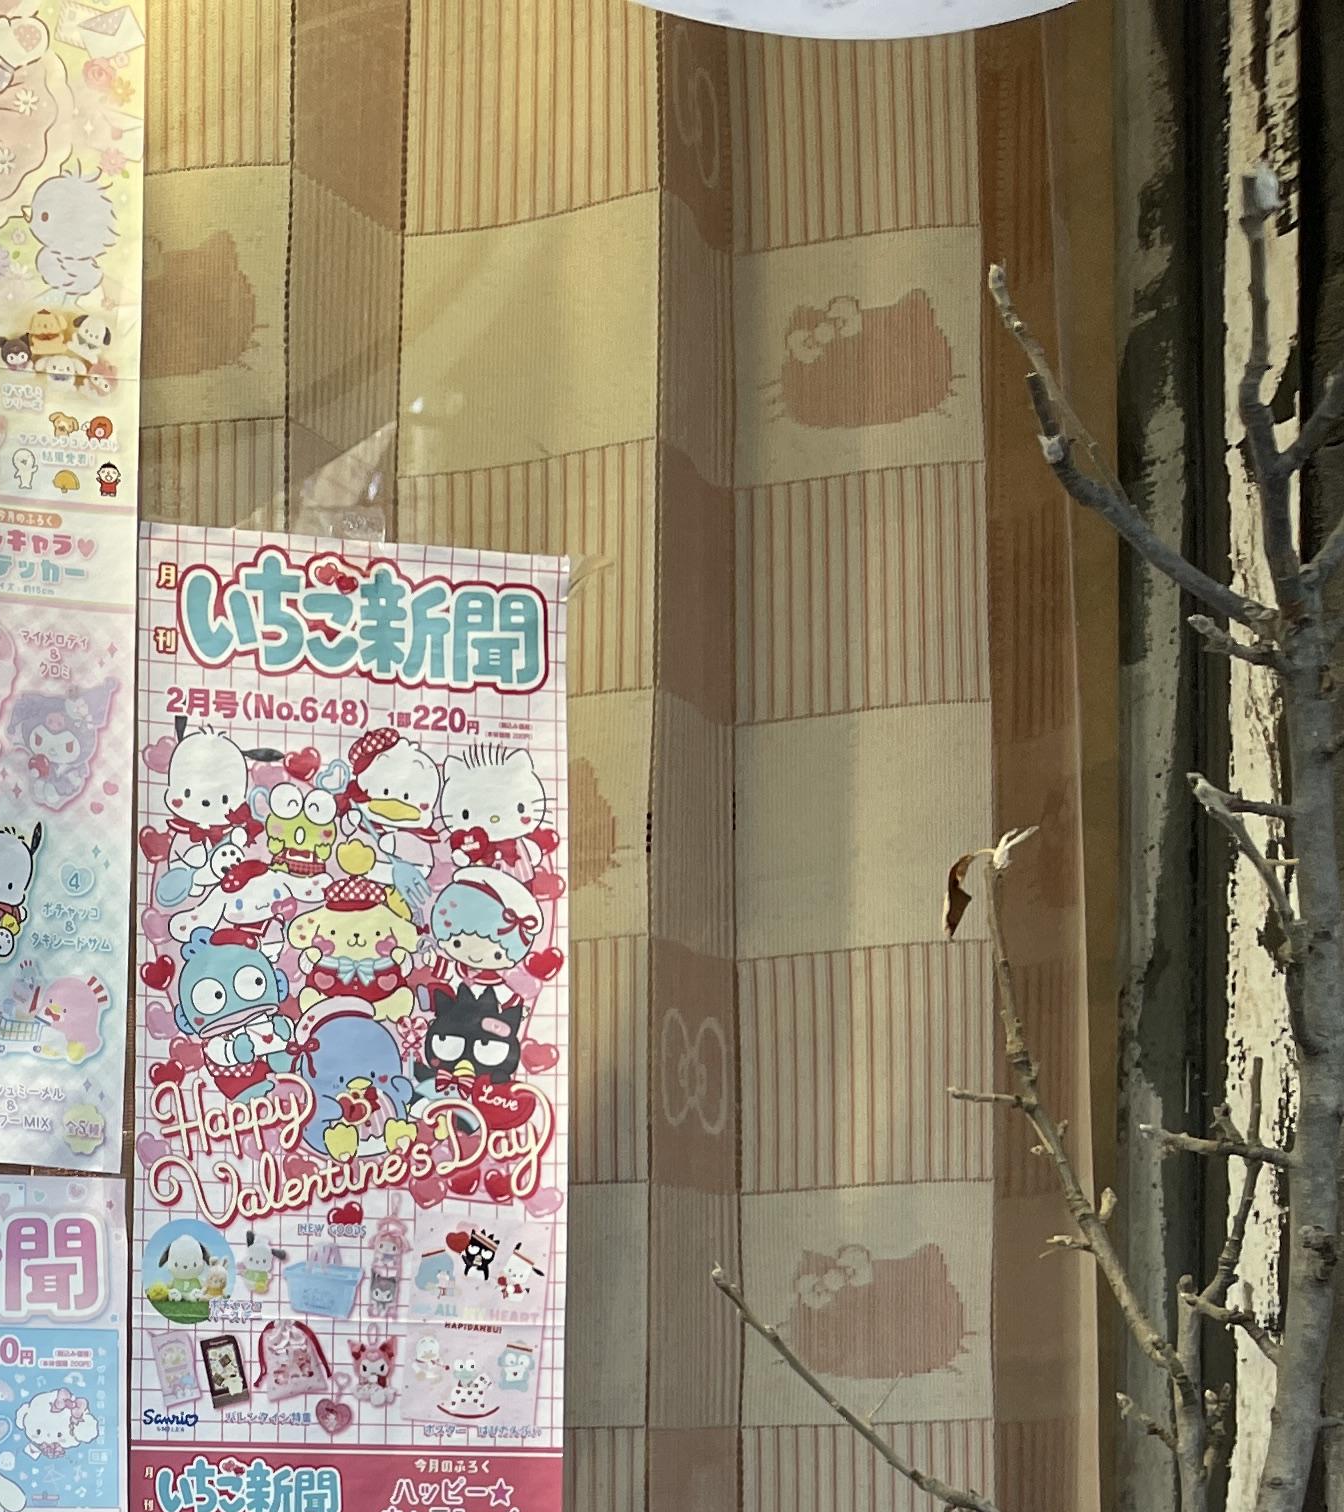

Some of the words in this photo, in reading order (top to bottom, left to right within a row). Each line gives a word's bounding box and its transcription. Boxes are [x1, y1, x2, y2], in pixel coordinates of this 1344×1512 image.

[184, 553, 540, 685] いちご新聞
[20, 628, 88, 651] マイメロディ
[38, 661, 71, 680] クロミ
[165, 686, 371, 730] 2月号(No.648)
[387, 703, 481, 736] 1部220円
[69, 873, 81, 891] 4
[42, 902, 101, 920] ポチャッコ
[478, 1084, 520, 1113] Love
[150, 1072, 316, 1160] Happy
[148, 1138, 434, 1226] Valentine's
[423, 1082, 554, 1200] Day
[143, 1409, 199, 1428] Sanrio
[414, 1459, 490, 1474] 今月のふろく
